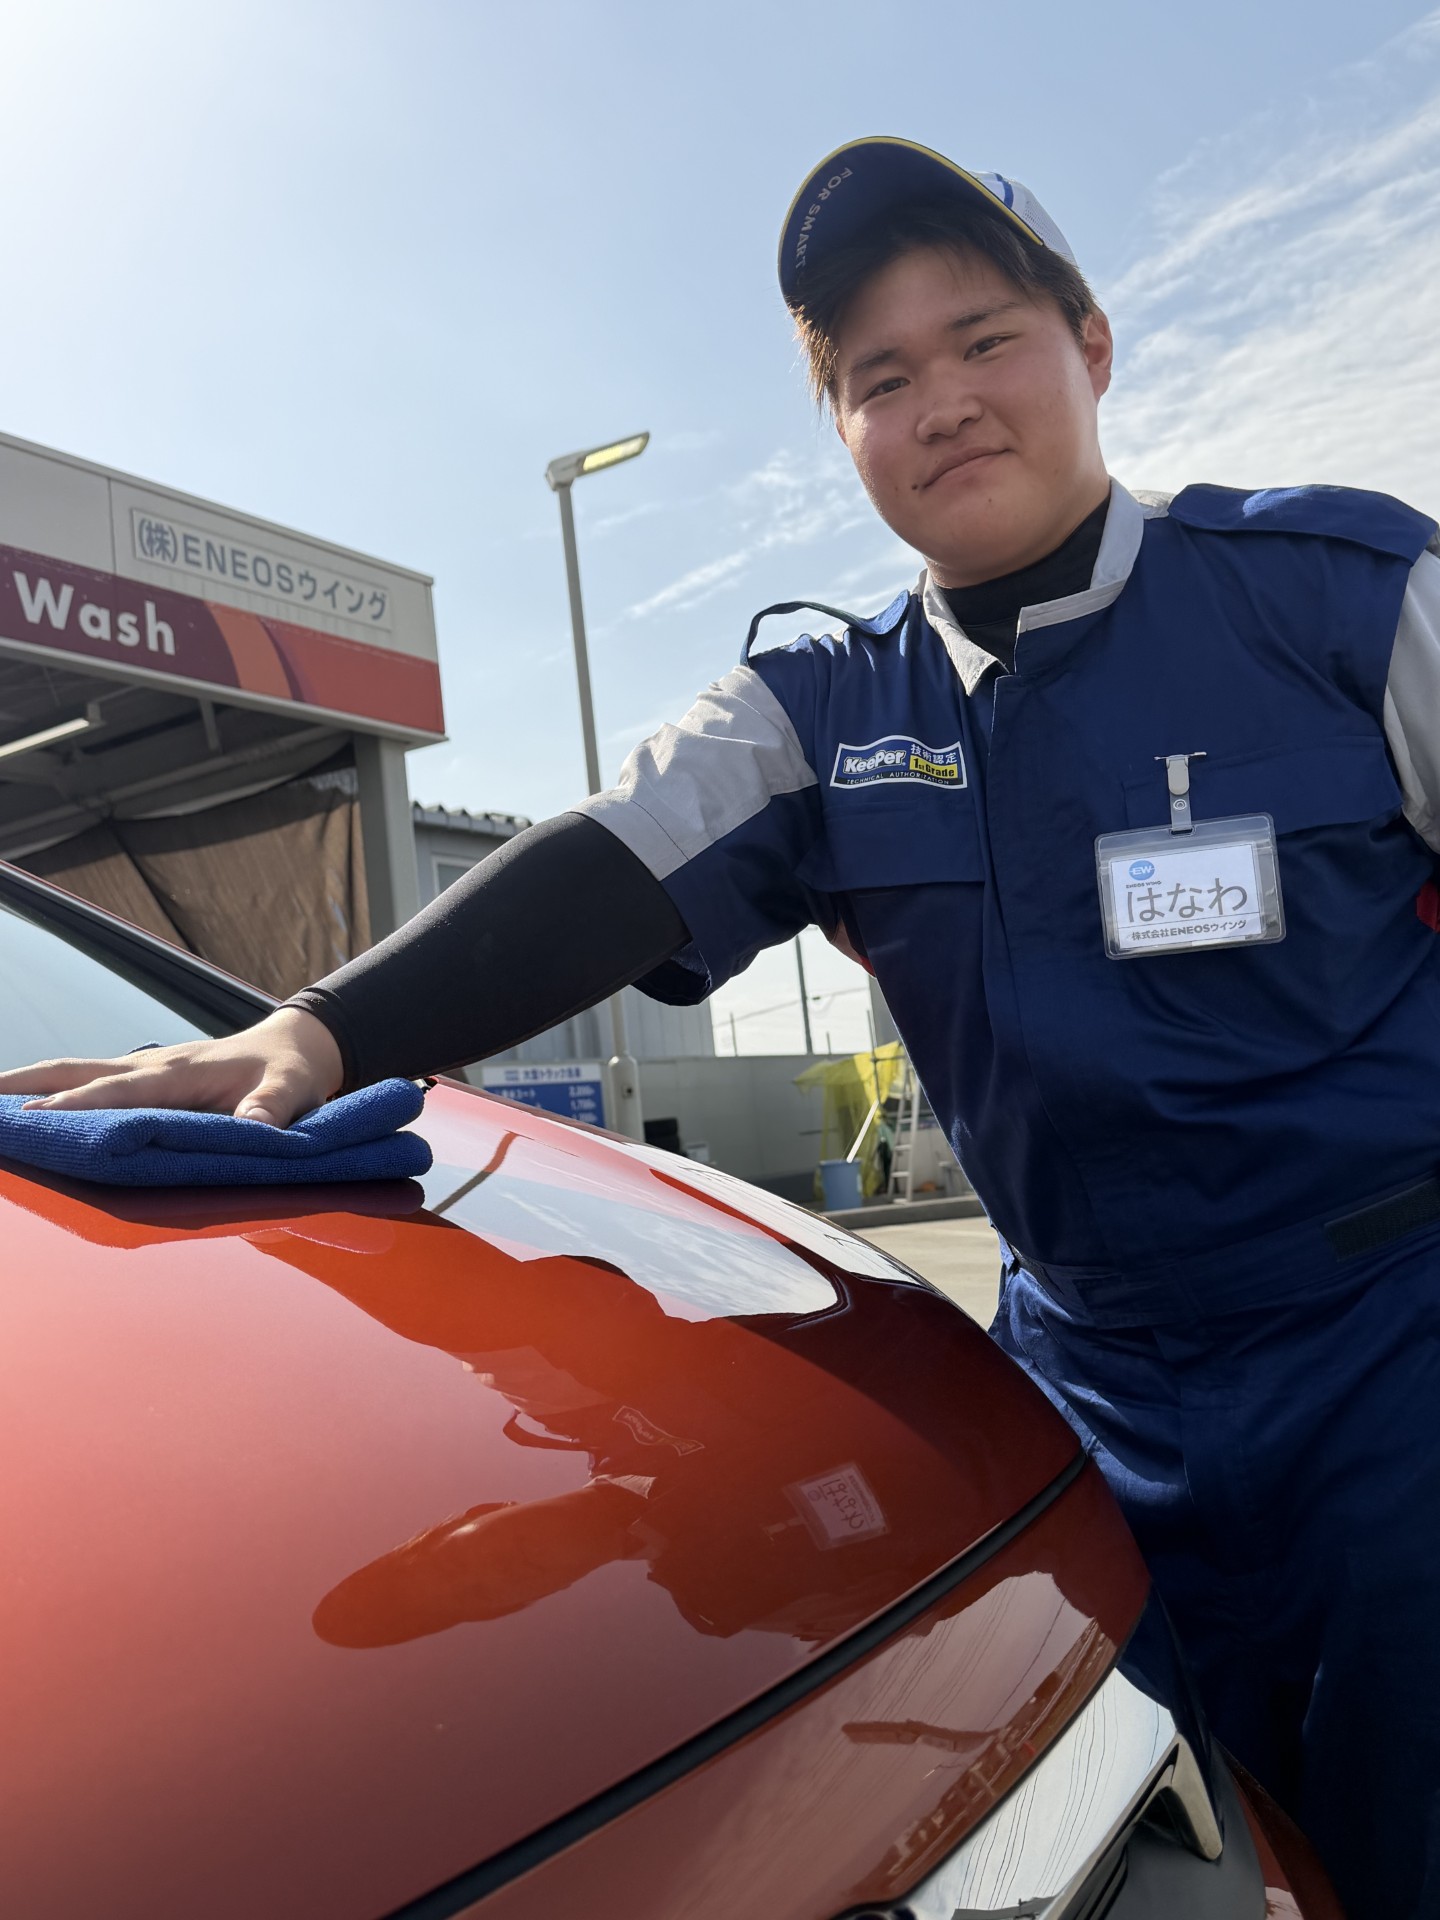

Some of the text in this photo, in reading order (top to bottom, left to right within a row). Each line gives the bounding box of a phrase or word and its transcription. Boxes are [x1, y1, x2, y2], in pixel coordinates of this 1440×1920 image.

[796, 168, 853, 268] FOR SMART
[138, 518, 388, 621] (株)ENEOSウイング
[13, 571, 176, 656] Wash
[844, 751, 906, 773] KeePer
[911, 744, 957, 764] 技術認定
[847, 772, 949, 784] TECHNICAL AUTHORIZATION
[925, 765, 955, 777] Grade
[1133, 865, 1152, 875] EW
[1128, 878, 1247, 922] はなわ
[1131, 919, 1247, 941] 株式会社ENEOSウイング
